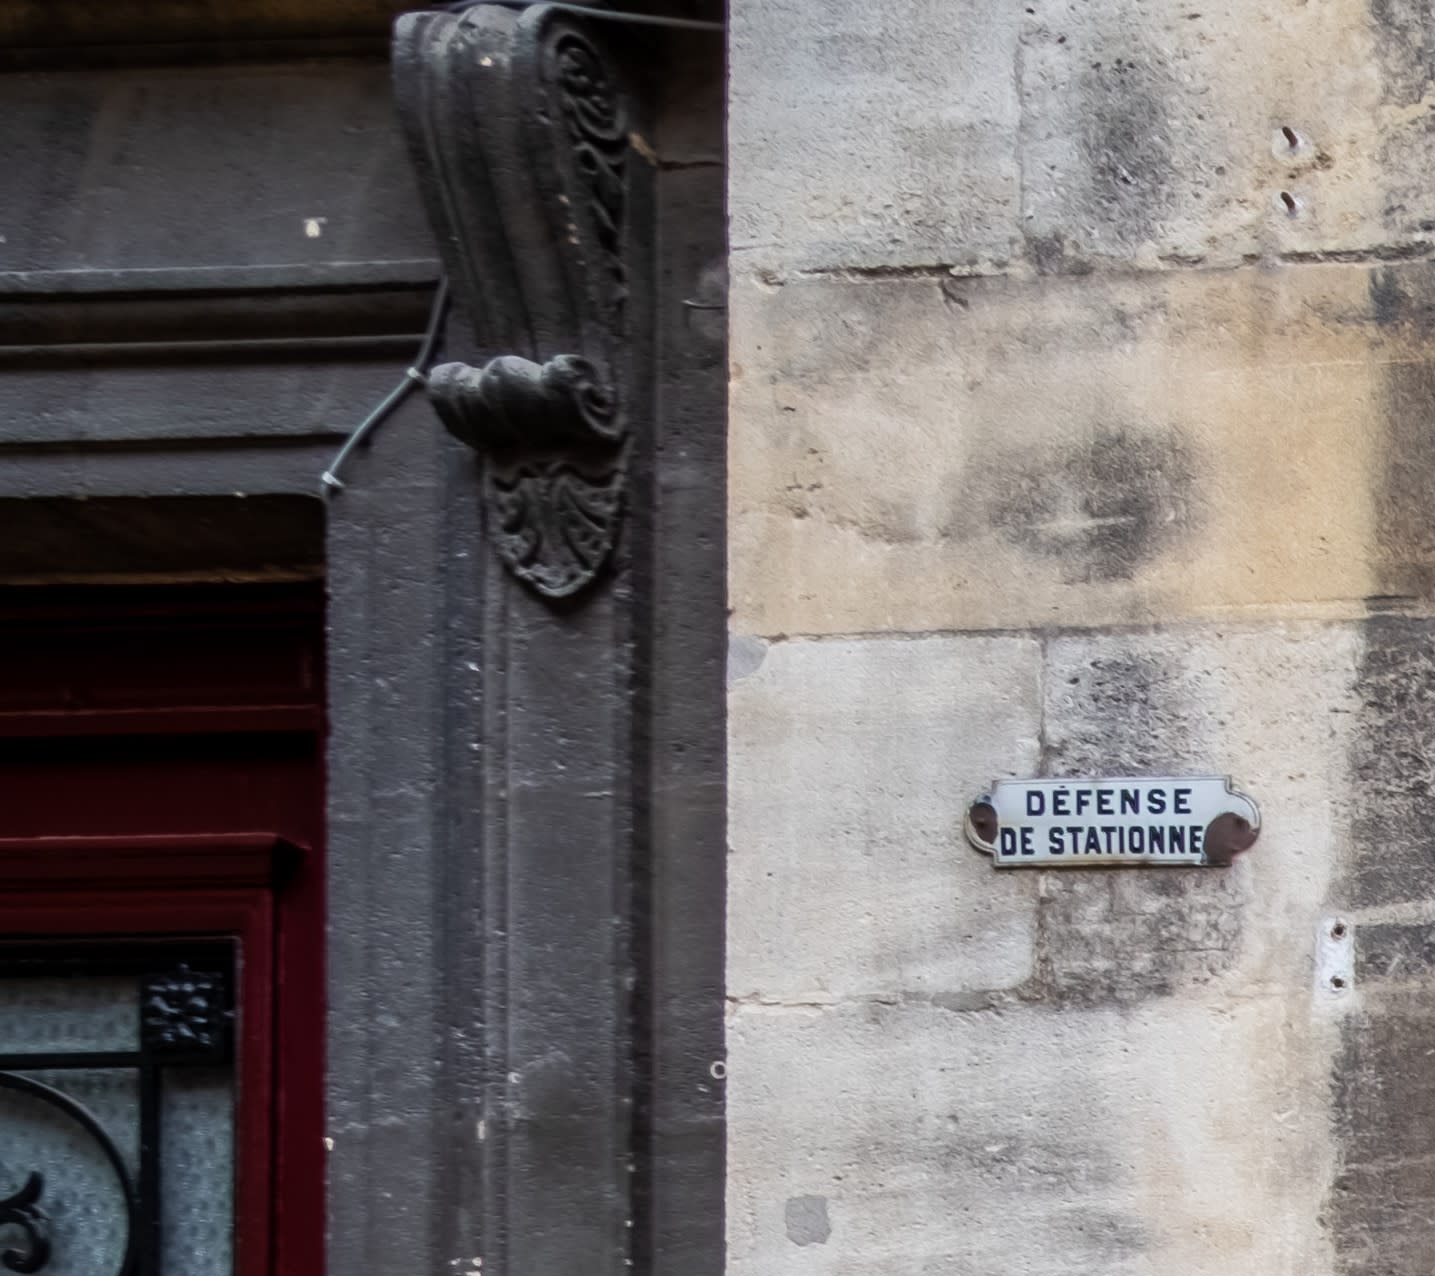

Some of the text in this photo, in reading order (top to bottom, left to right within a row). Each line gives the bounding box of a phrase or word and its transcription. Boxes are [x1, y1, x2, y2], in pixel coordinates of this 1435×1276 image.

[1026, 785, 1193, 817] DÉFENSE
[1000, 825, 1205, 857] DE STATIONNE
